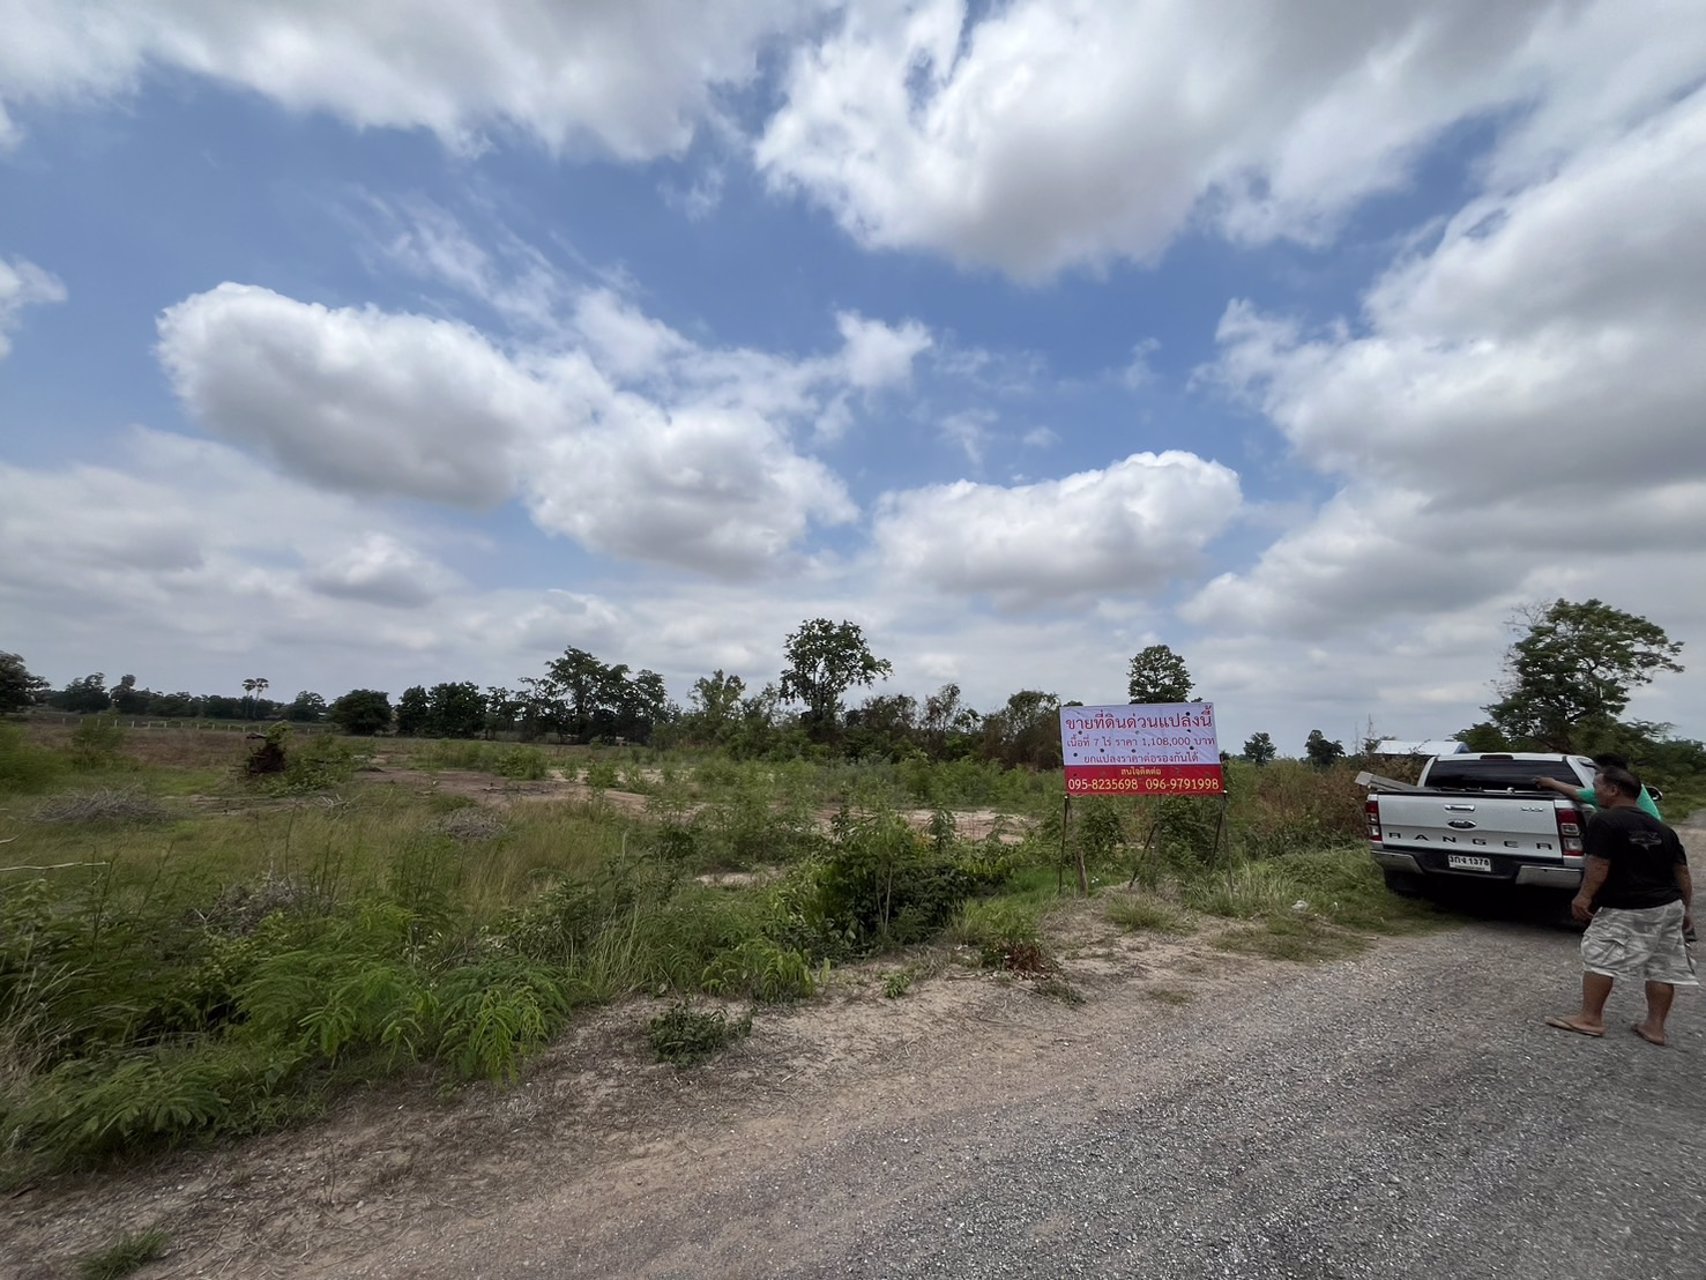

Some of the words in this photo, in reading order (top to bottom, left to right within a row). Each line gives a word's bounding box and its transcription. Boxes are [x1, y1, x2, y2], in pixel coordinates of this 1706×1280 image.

[1065, 705, 1212, 729] ขายที่ดินด่วนแปลงนี้
[1066, 735, 1090, 748] เนื้อที่
[1094, 738, 1099, 746] 7
[1102, 736, 1112, 746] ไร่
[1116, 739, 1137, 747] ราคา
[1142, 737, 1190, 748] 1,108,000
[1194, 737, 1215, 747] บาท
[1068, 778, 1139, 790] 095-8235698
[1145, 778, 1220, 790] 096-9791998
[1388, 831, 1553, 851] RANGER
